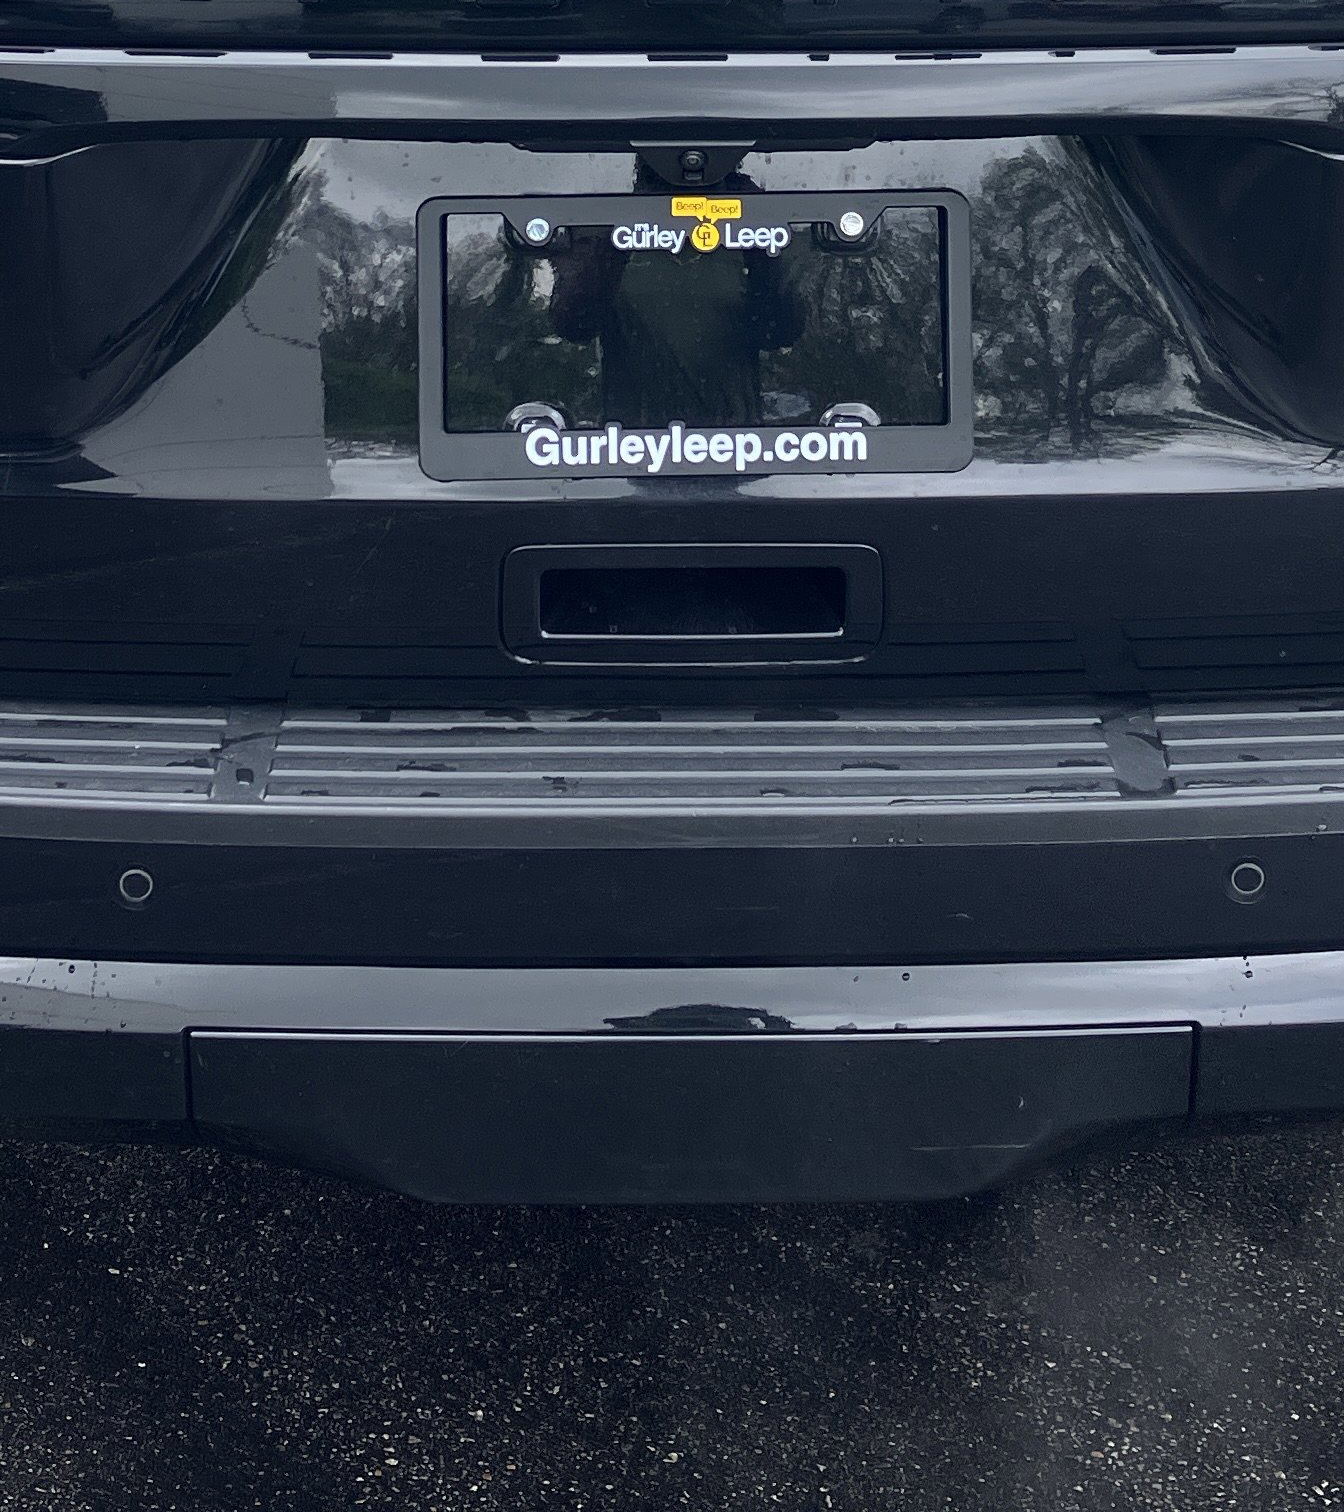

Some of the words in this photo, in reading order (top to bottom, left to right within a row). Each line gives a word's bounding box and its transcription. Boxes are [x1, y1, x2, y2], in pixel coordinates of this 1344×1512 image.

[711, 205, 738, 214] Beep!
[613, 224, 685, 254] Gurley
[725, 223, 788, 253] Leep
[525, 425, 868, 473] Gurleyleep.com
